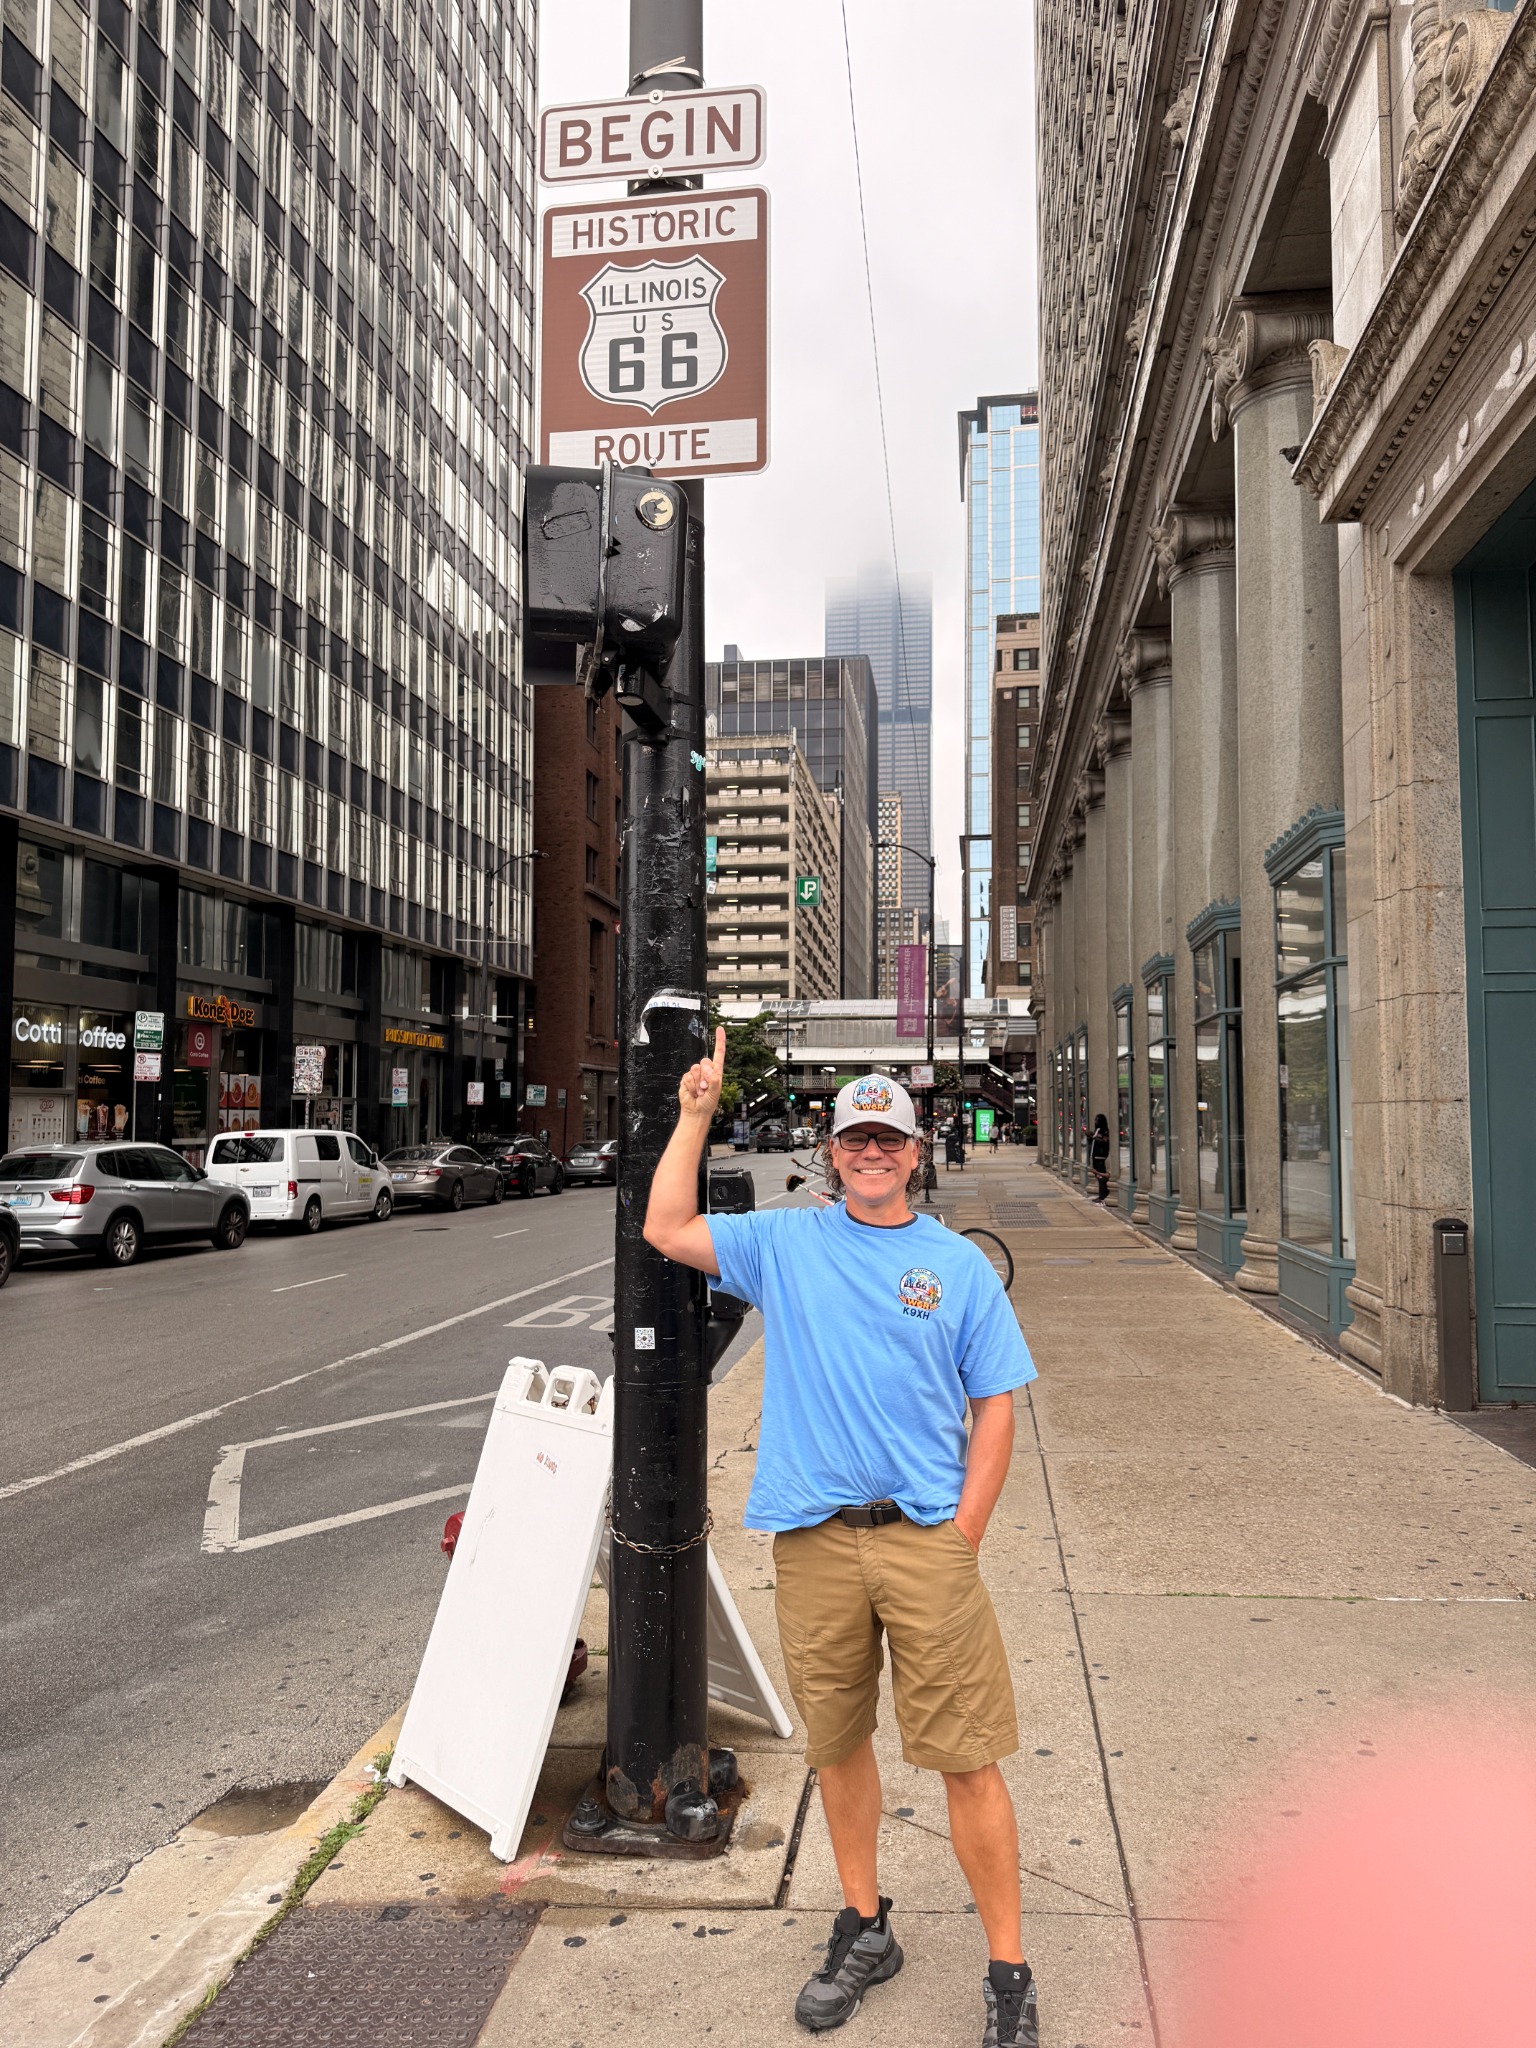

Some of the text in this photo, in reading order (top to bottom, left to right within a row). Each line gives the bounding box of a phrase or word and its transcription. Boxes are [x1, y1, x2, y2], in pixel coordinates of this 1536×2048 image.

[558, 103, 742, 168] BEGIN
[572, 205, 736, 250] HISTORIC
[601, 276, 707, 307] ILLINOIS
[608, 331, 698, 394] 66
[594, 428, 711, 467] ROUTE
[194, 996, 255, 1026] Kong Dog
[15, 1017, 62, 1044] Cotti
[79, 1025, 126, 1050] offee
[83, 1074, 106, 1085] Coffee
[867, 1086, 879, 1094] 66
[916, 1280, 927, 1290] 66
[902, 1306, 930, 1320] K9XH
